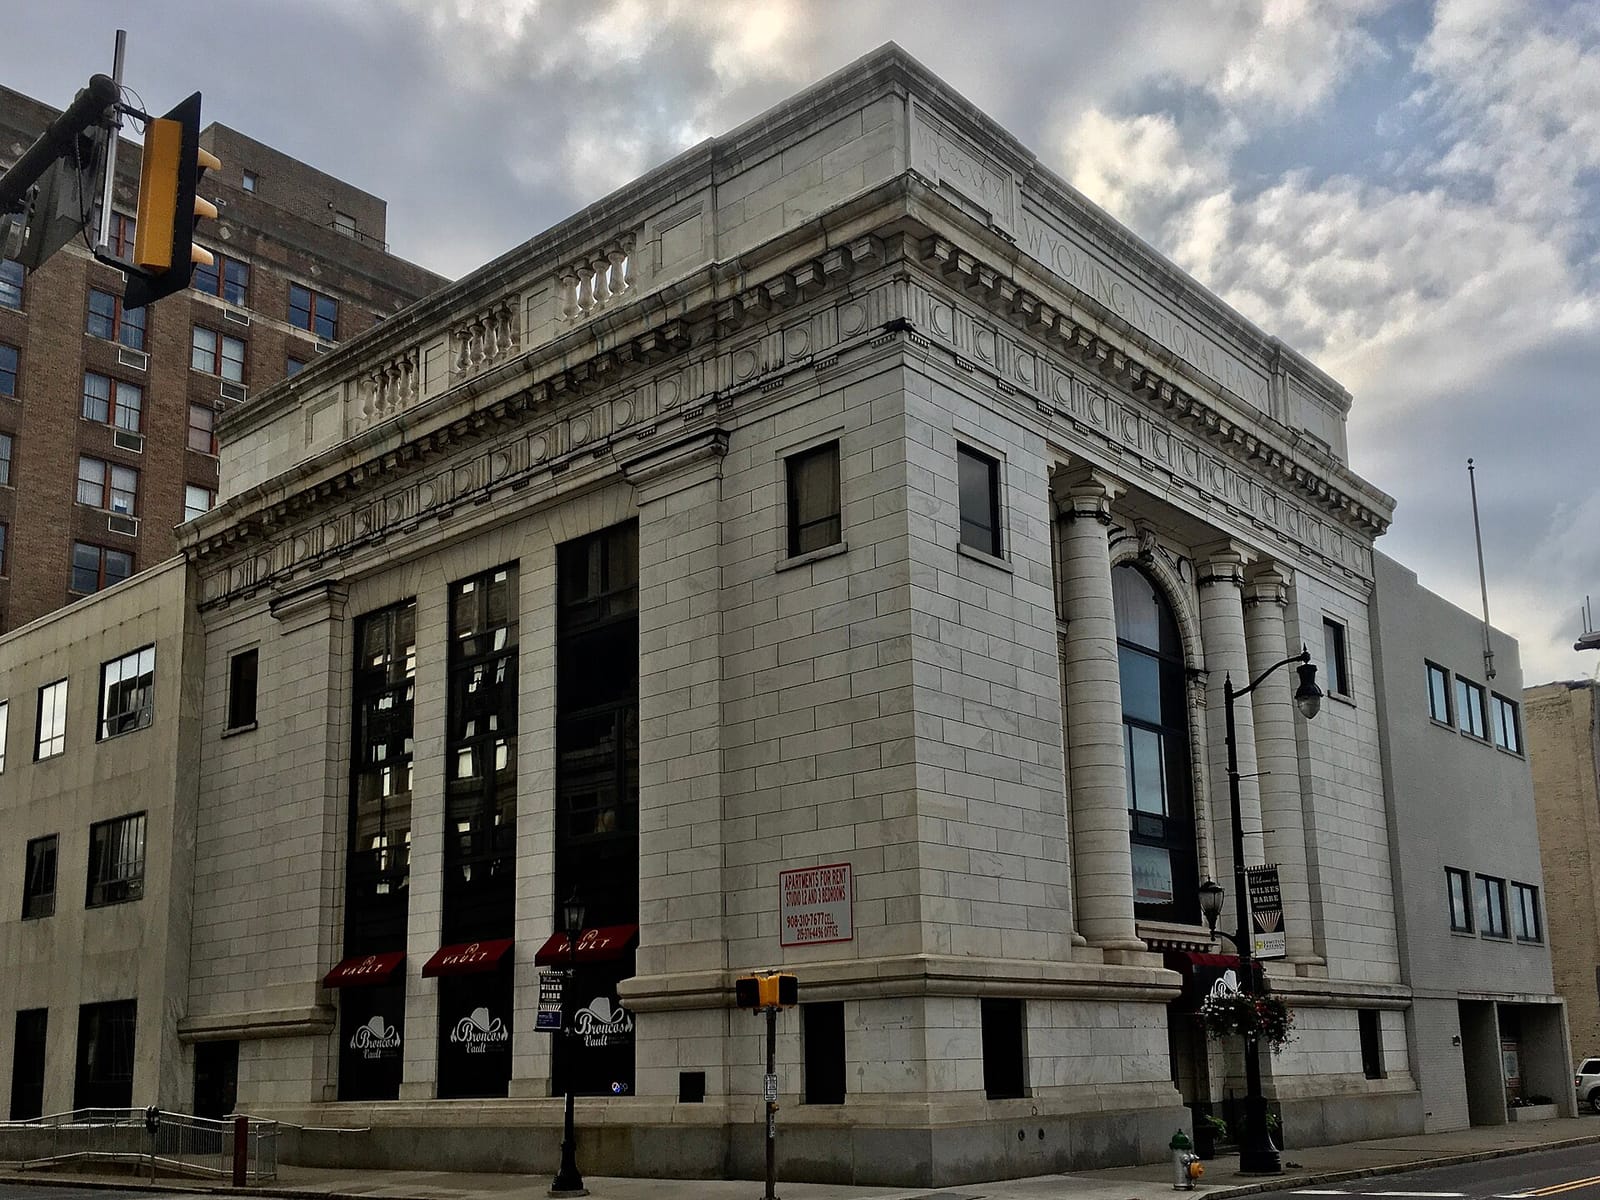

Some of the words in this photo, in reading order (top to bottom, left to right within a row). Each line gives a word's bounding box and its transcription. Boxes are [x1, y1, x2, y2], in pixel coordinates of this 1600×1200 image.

[1023, 218, 1126, 314] WYOMING
[1129, 295, 1221, 378] NATIONAL
[1224, 358, 1266, 408] BANK
[784, 871, 819, 891] APARTMENTS
[820, 870, 831, 886] FOR
[832, 868, 846, 884] RENT
[822, 885, 846, 903] BEDROOMS
[1250, 885, 1280, 895] WILKES
[1253, 894, 1279, 904] BARRE
[442, 952, 488, 965] VAULT
[342, 964, 383, 976] VAULT
[575, 1011, 625, 1035] Broncos
[457, 1021, 501, 1043] Broncos
[356, 1029, 396, 1049] Broncos
[583, 1034, 608, 1047] Vault
[362, 1048, 382, 1059] Vault
[465, 1042, 486, 1054] Vault
